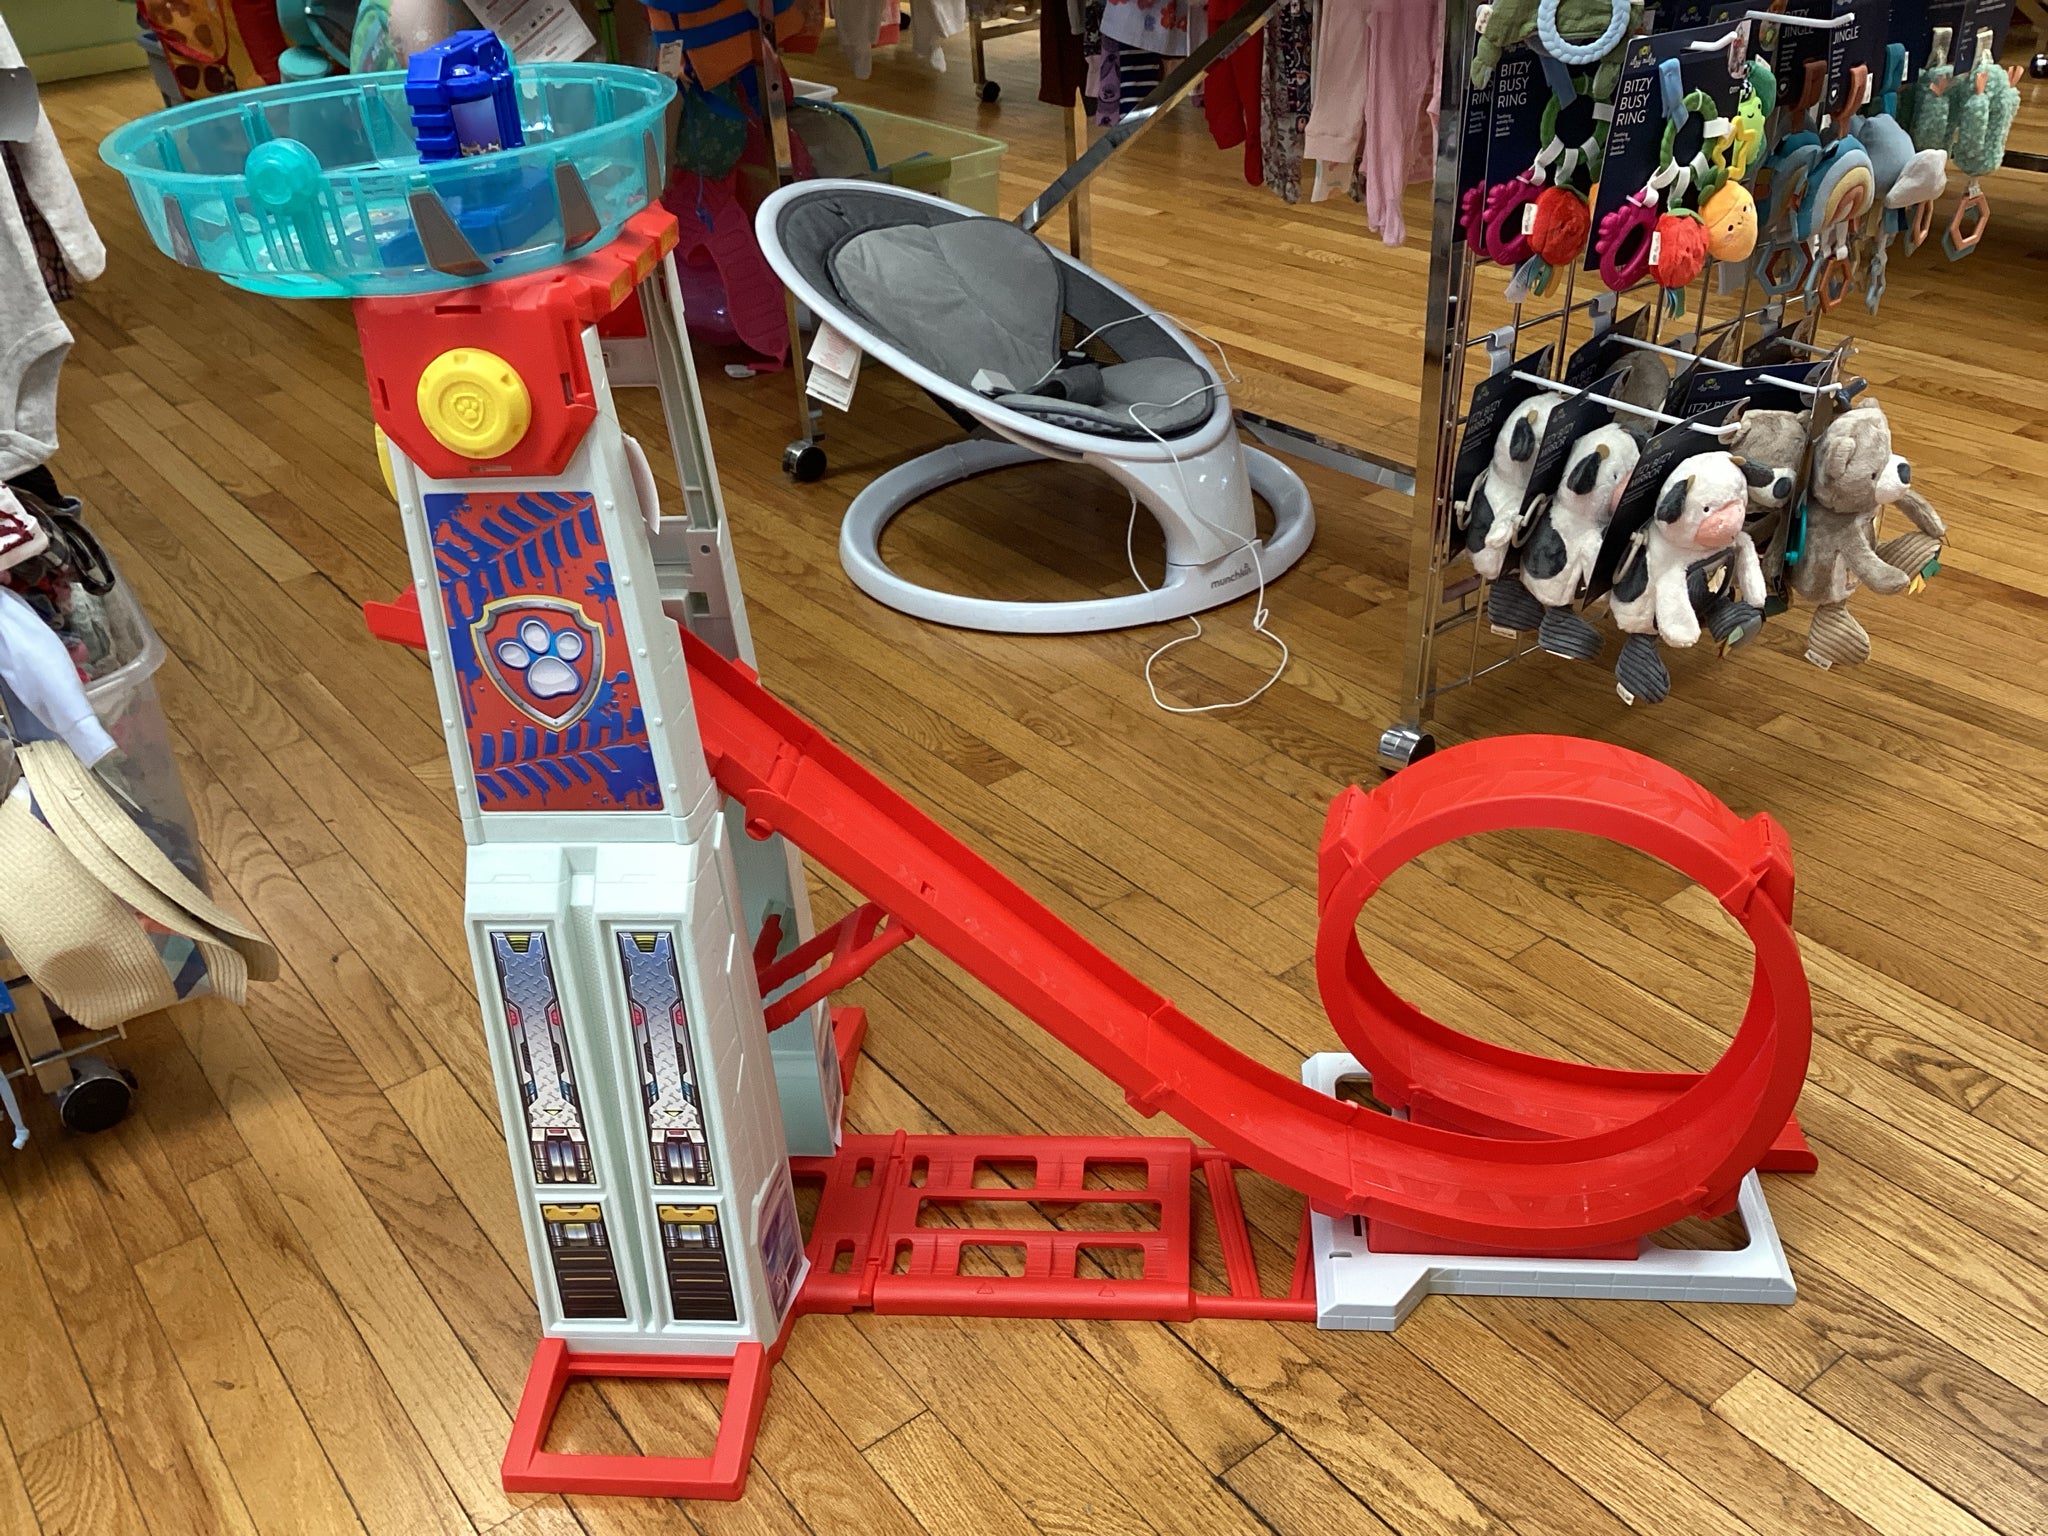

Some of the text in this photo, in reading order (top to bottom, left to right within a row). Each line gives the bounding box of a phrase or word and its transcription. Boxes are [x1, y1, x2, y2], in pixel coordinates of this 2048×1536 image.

[1832, 25, 1861, 45] JINGLE
[1500, 60, 1532, 77] BITZY
[1499, 76, 1530, 93] BUSY
[1623, 76, 1653, 94] BITZY
[1471, 91, 1492, 106] RIN
[1497, 92, 1527, 109] RING
[1619, 92, 1650, 111] BUSY
[1616, 109, 1646, 126] RING
[1210, 563, 1251, 589] munchkin
